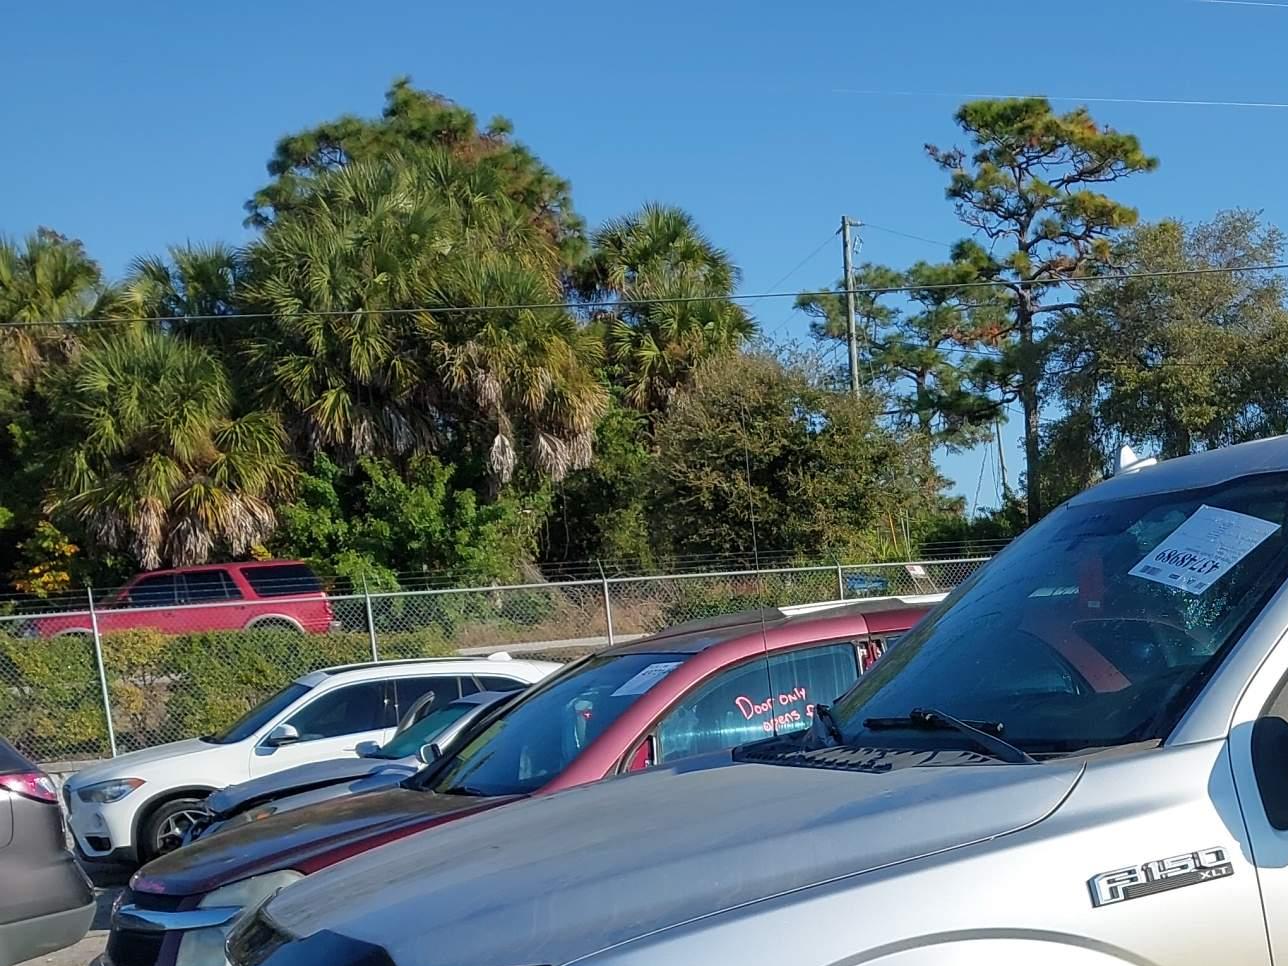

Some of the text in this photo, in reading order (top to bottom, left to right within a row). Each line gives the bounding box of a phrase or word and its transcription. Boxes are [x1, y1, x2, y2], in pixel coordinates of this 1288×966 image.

[1154, 548, 1220, 575] 43748989
[735, 697, 775, 720] Door
[1200, 867, 1229, 880] XLT
